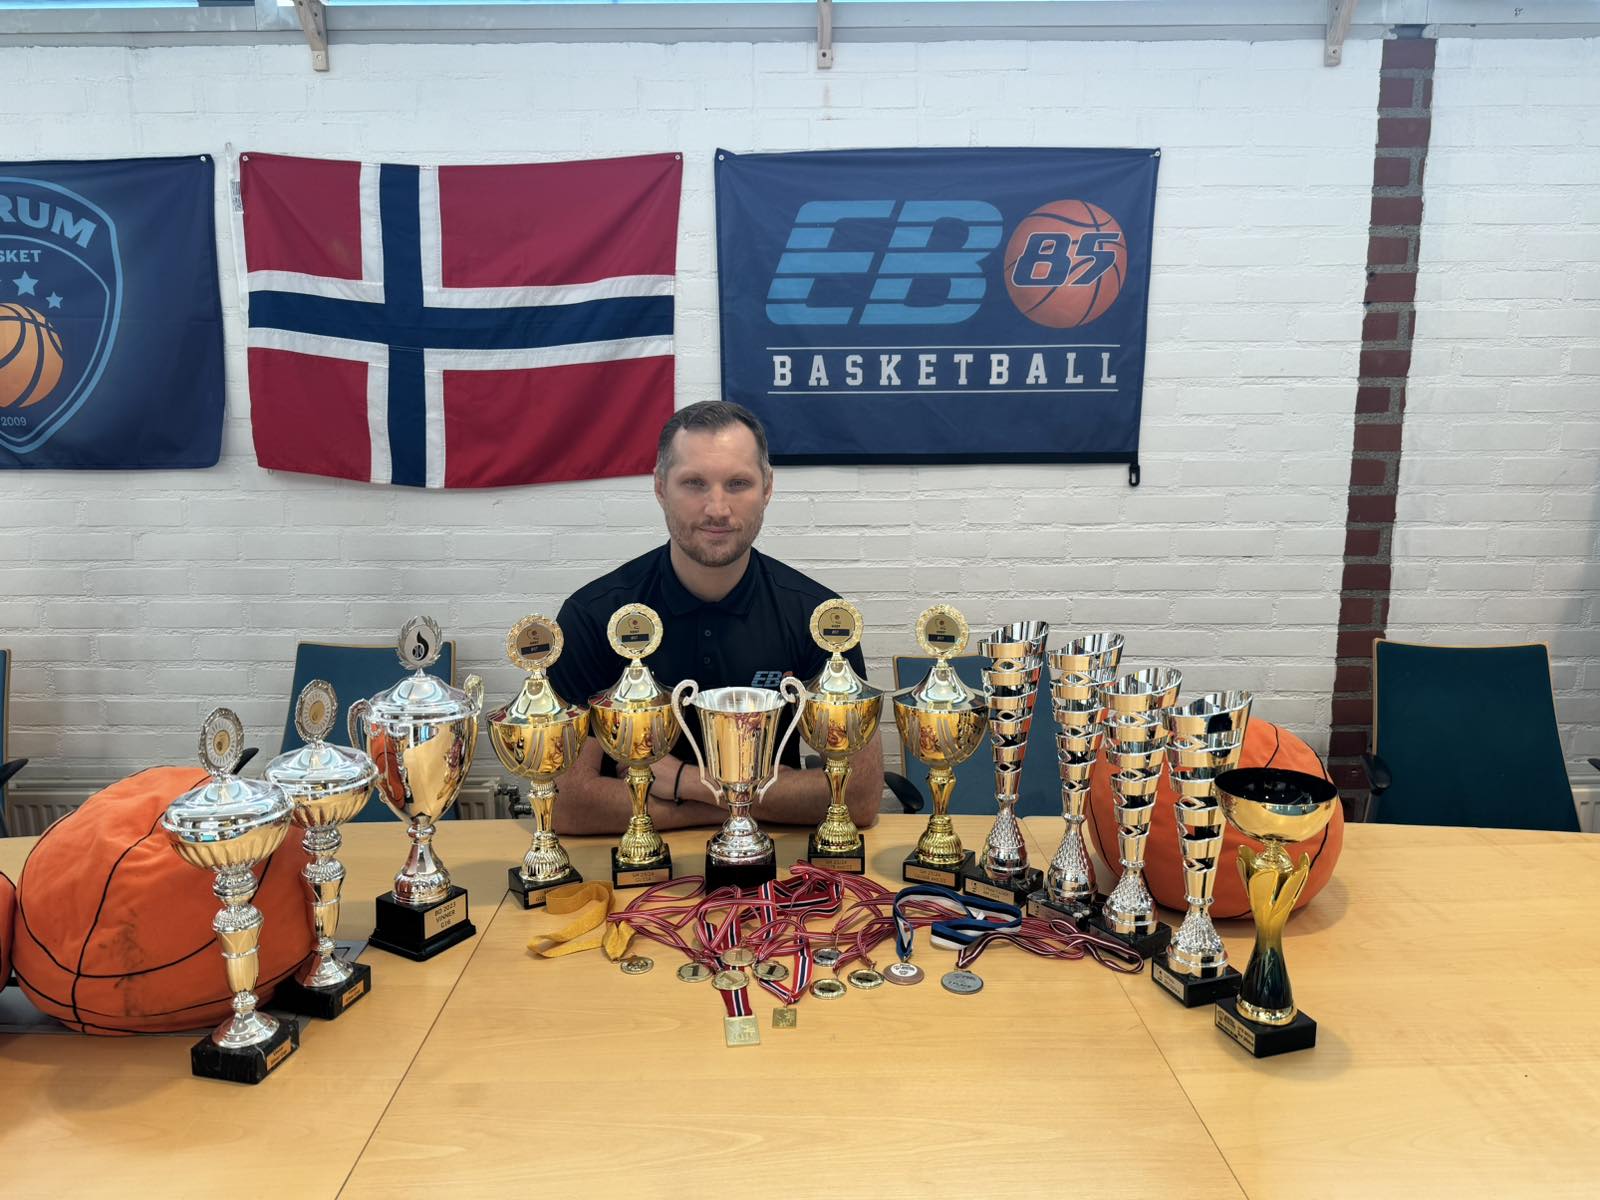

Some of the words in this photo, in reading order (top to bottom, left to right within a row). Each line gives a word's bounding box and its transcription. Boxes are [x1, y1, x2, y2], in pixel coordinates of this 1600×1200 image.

[765, 199, 1004, 325] EB
[1011, 231, 1122, 287] 85
[772, 352, 1118, 387] BASKETBALL
[1, 416, 27, 426] 2009
[436, 909, 456, 923] VINNER
